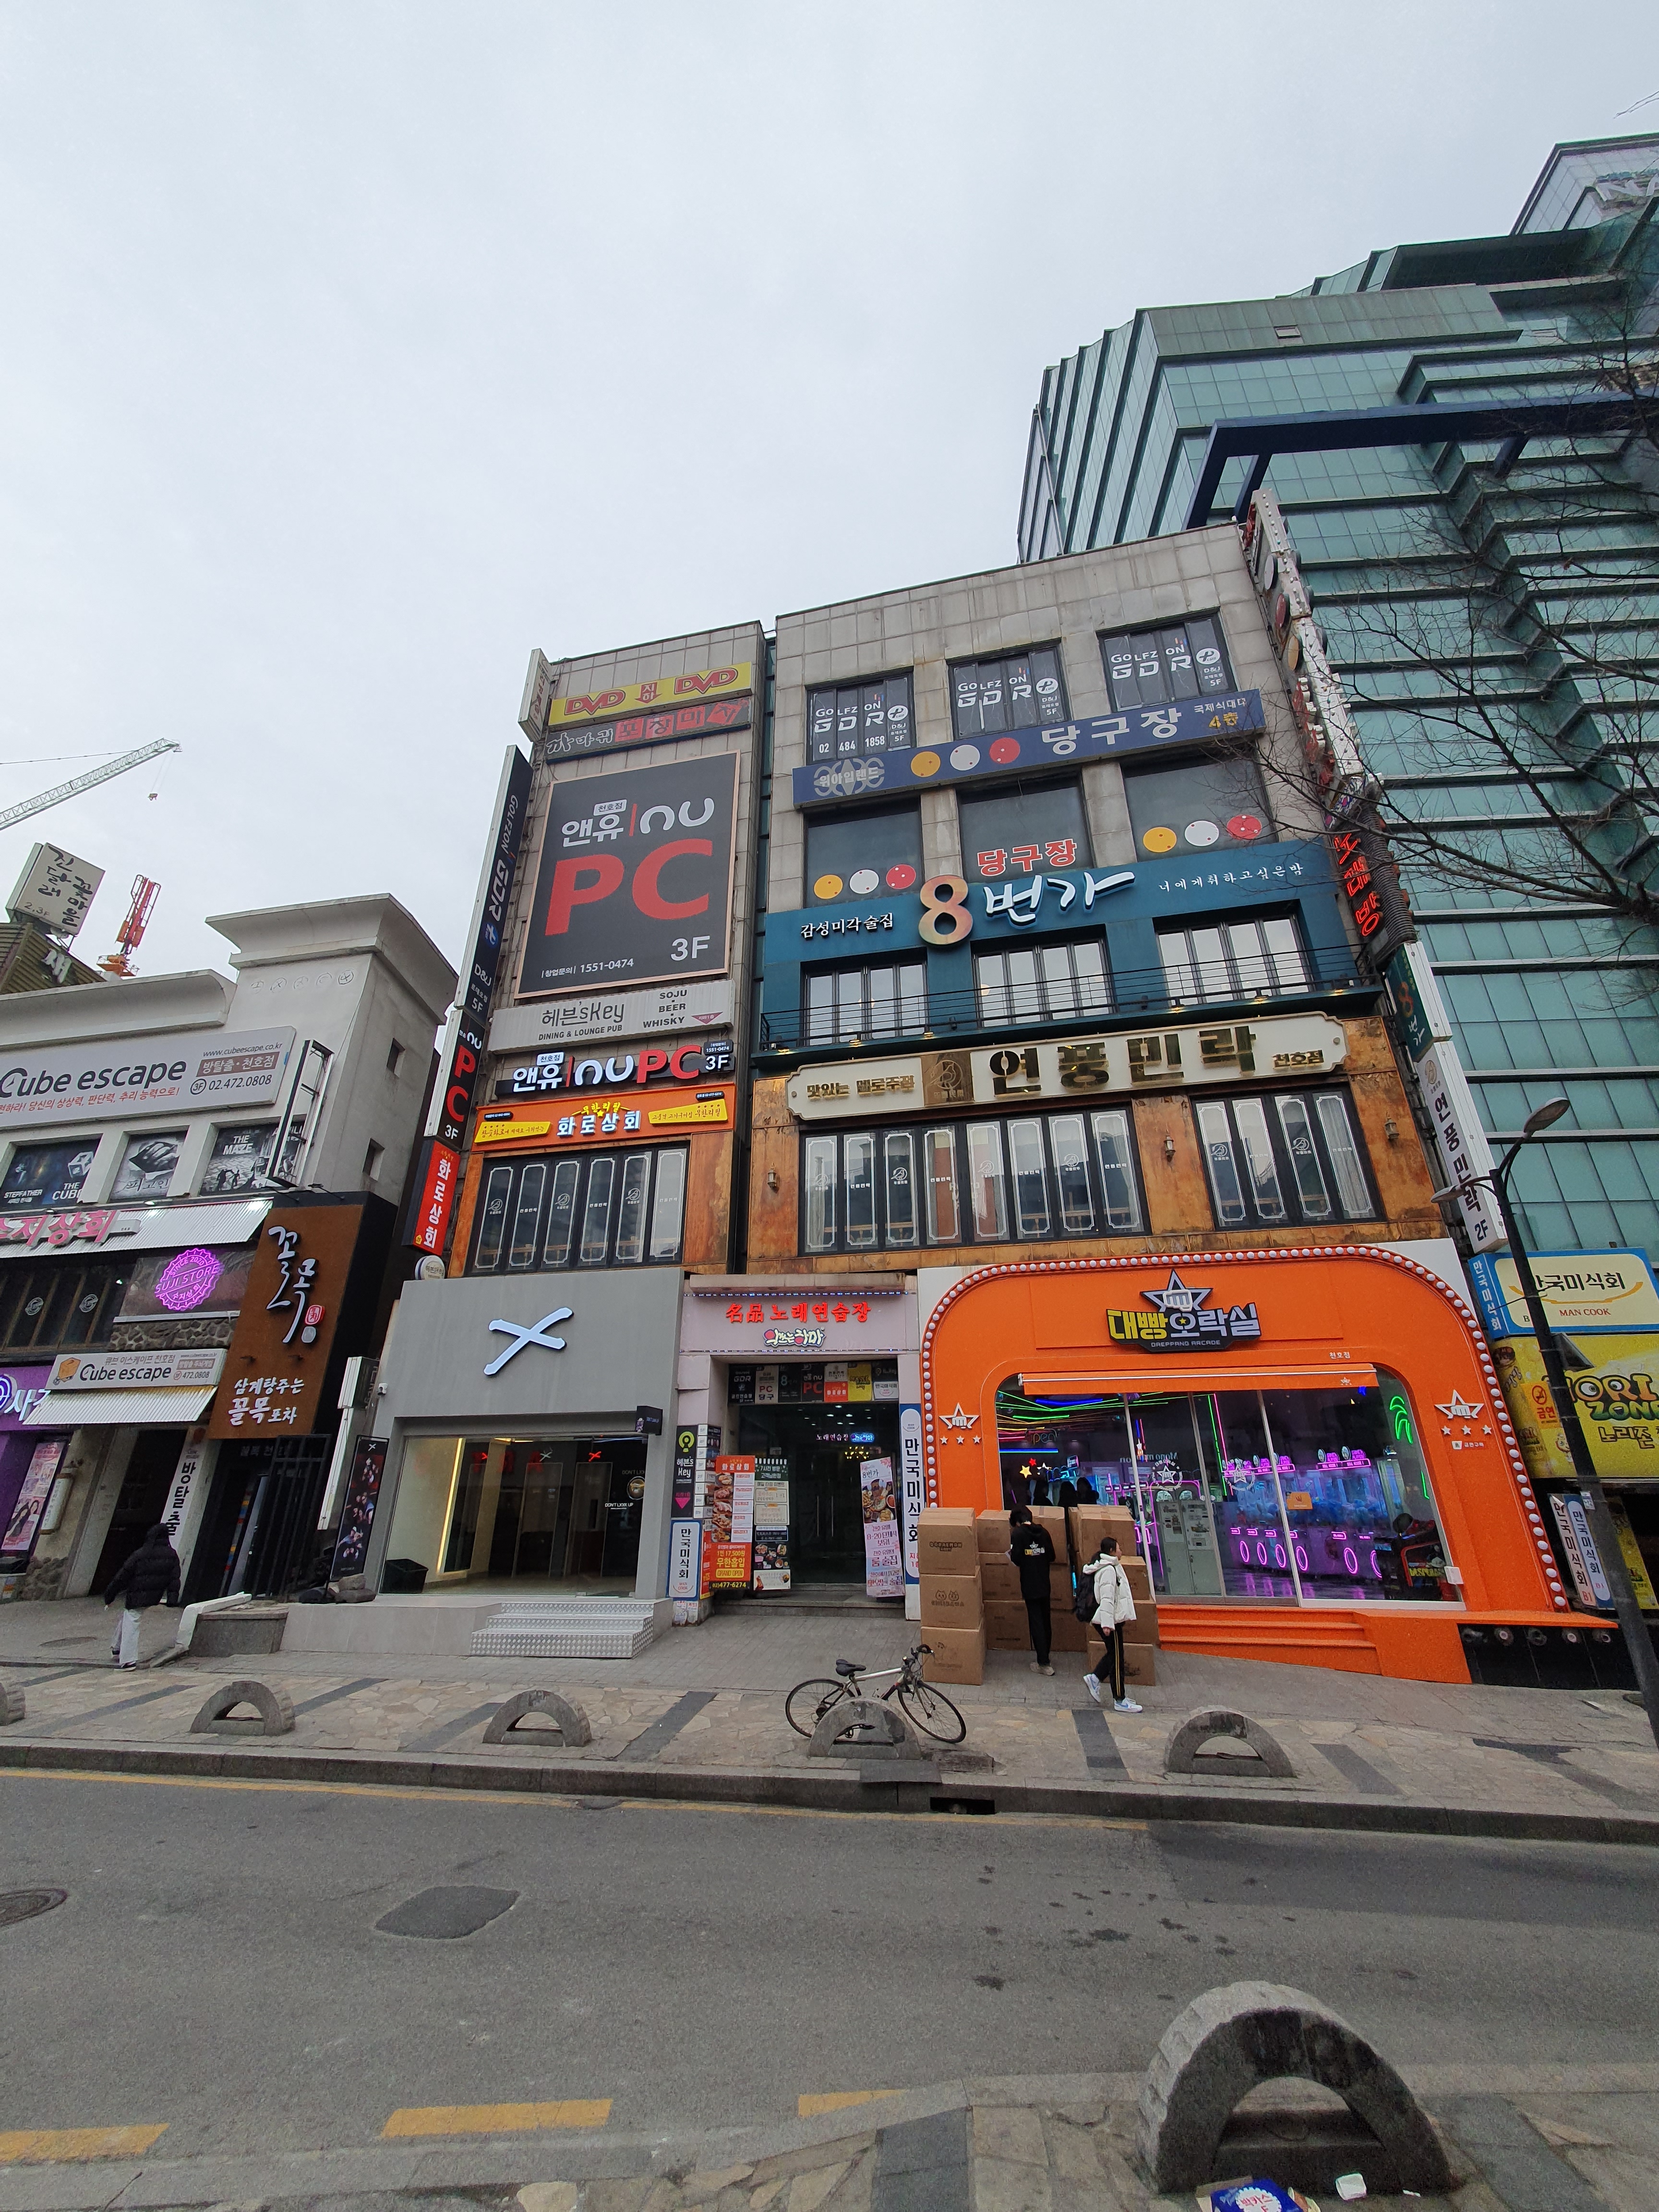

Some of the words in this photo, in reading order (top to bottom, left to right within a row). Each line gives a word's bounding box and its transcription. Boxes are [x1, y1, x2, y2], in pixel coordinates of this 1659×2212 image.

[1112, 655, 1191, 679] GDR
[674, 667, 738, 694] DVD
[641, 682, 658, 701] 지하
[957, 685, 1032, 708] GDR
[564, 689, 626, 716] DVD
[814, 711, 884, 733] GDR
[1042, 708, 1182, 755] 당구장
[546, 728, 613, 754] 까마귀
[819, 743, 830, 753] 02
[839, 741, 856, 751] 484
[865, 736, 885, 747] 1858
[819, 767, 879, 787] 위아일랜드
[598, 801, 623, 813] 천호점
[500, 795, 519, 853] GOLFZON
[562, 814, 624, 847] 앤유
[977, 838, 1077, 876] 당구장
[37, 845, 74, 897] 진달래
[488, 859, 510, 923] GDR
[544, 839, 713, 936] PC
[61, 876, 93, 927] 꽃마을
[919, 871, 1135, 945] 8번가
[670, 936, 710, 961] 3F
[580, 958, 634, 973] 1551-0474
[659, 989, 687, 999] SOJU
[472, 998, 483, 1012] 5F
[659, 1003, 686, 1012] BEER
[643, 1016, 685, 1028] WHISKY
[538, 1031, 565, 1041] DINING
[574, 1027, 605, 1036] LOUNGE
[607, 1024, 623, 1033] PUB
[203, 1043, 283, 1057] www.cubeescape.co.kr
[540, 1054, 561, 1063] 천호점
[203, 1058, 235, 1074] 방탈출
[242, 1054, 275, 1070] 천호점
[513, 1064, 562, 1092] 앤유
[637, 1045, 702, 1083] PC
[705, 1054, 729, 1070] 3F
[0, 1068, 72, 1098] Cube
[77, 1060, 187, 1090] escape
[192, 1082, 204, 1091] 3F
[208, 1074, 273, 1091] 02.472.0808
[447, 1045, 476, 1122] PC
[29, 1099, 56, 1111] 당신의
[57, 1096, 84, 1108] 상상력,
[88, 1093, 116, 1105] 판단력,
[119, 1091, 138, 1101] 추리
[139, 1087, 180, 1100] 능력으로!
[581, 1102, 622, 1115] 무한리필
[445, 1124, 459, 1141] 3F
[557, 1110, 640, 1137] 화로상회
[233, 1134, 251, 1144] THE
[222, 1143, 254, 1155] MAZE
[3, 1189, 43, 1199] STEPFATHER
[63, 1182, 81, 1190] THE
[423, 1158, 451, 1249] 화로상회
[1474, 1219, 1488, 1242] 2F
[170, 1258, 189, 1276] SINCE
[190, 1257, 204, 1266] 2020
[155, 1277, 180, 1294] SUJI
[182, 1263, 220, 1284] STORE
[726, 1303, 764, 1323] 名品
[769, 1301, 871, 1322] 노래연습장
[1107, 1303, 1261, 1340] 대빵오락실
[1583, 1308, 1611, 1316] COOK
[105, 1357, 119, 1366] 큐브
[120, 1355, 154, 1365] 이스케이프
[154, 1354, 175, 1364] 천호점
[1329, 1351, 1351, 1359] 천호점
[80, 1363, 118, 1382] Cube
[119, 1367, 171, 1382] escape
[182, 1371, 210, 1379] 472.0808
[234, 1377, 305, 1395] 삼계탕주는
[803, 1381, 822, 1394] PC
[267, 1407, 297, 1425] 포차
[1536, 1407, 1556, 1419] 금연
[1598, 1426, 1655, 1449] 노리존
[678, 1468, 691, 1478] Key
[862, 1469, 879, 1479] 8번가
[166, 1462, 196, 1536] 방탈출
[866, 1532, 881, 1540] 8-20
[1553, 1502, 1588, 1587] 만국미식회
[1573, 1511, 1600, 1574] 만국미식회
[678, 1528, 692, 1579] 만국미식회
[882, 1555, 898, 1566] 술집
[1582, 1591, 1592, 1602] B1
[1240, 2194, 1273, 2206] 박카스
